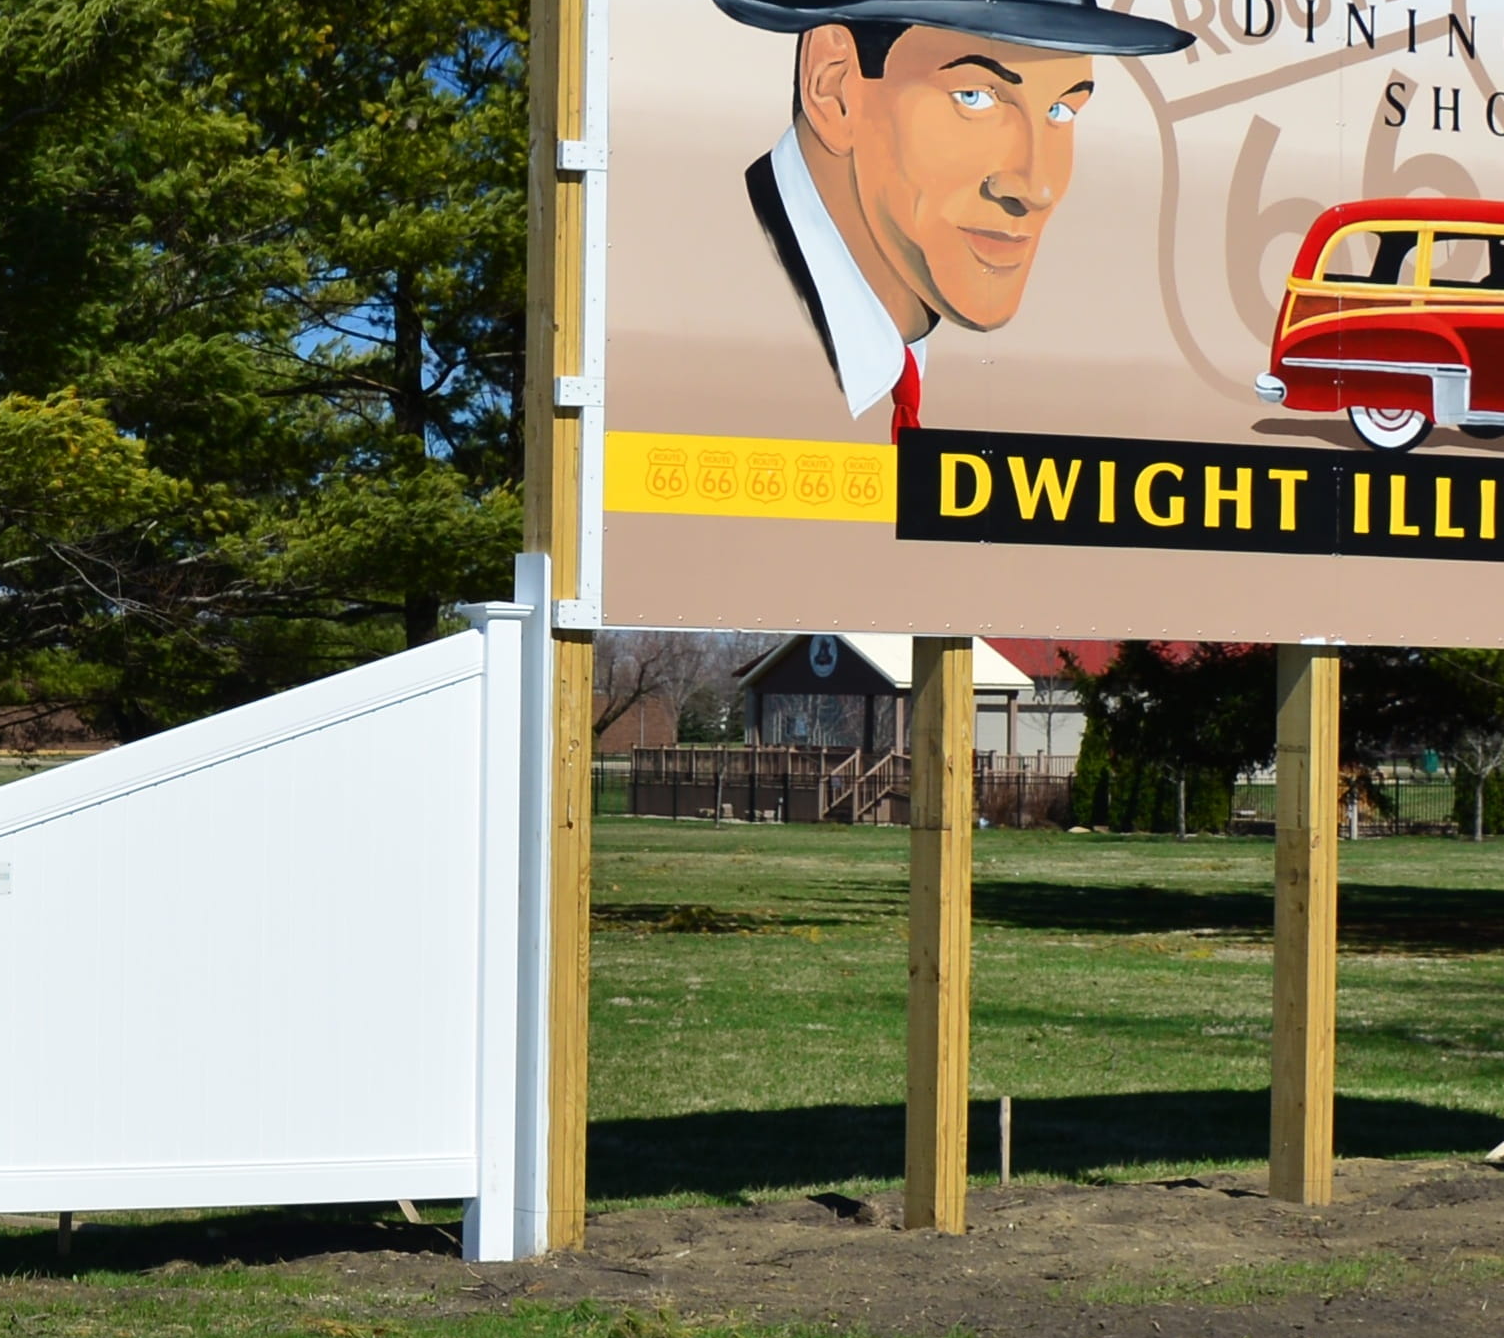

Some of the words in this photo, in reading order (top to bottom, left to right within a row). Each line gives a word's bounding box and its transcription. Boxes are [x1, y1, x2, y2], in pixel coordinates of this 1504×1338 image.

[652, 468, 682, 491] 66
[703, 470, 732, 493] 66
[752, 473, 780, 495] 66
[800, 475, 829, 497] 66
[848, 478, 877, 499] 66
[939, 452, 1308, 531] DWIGHT
